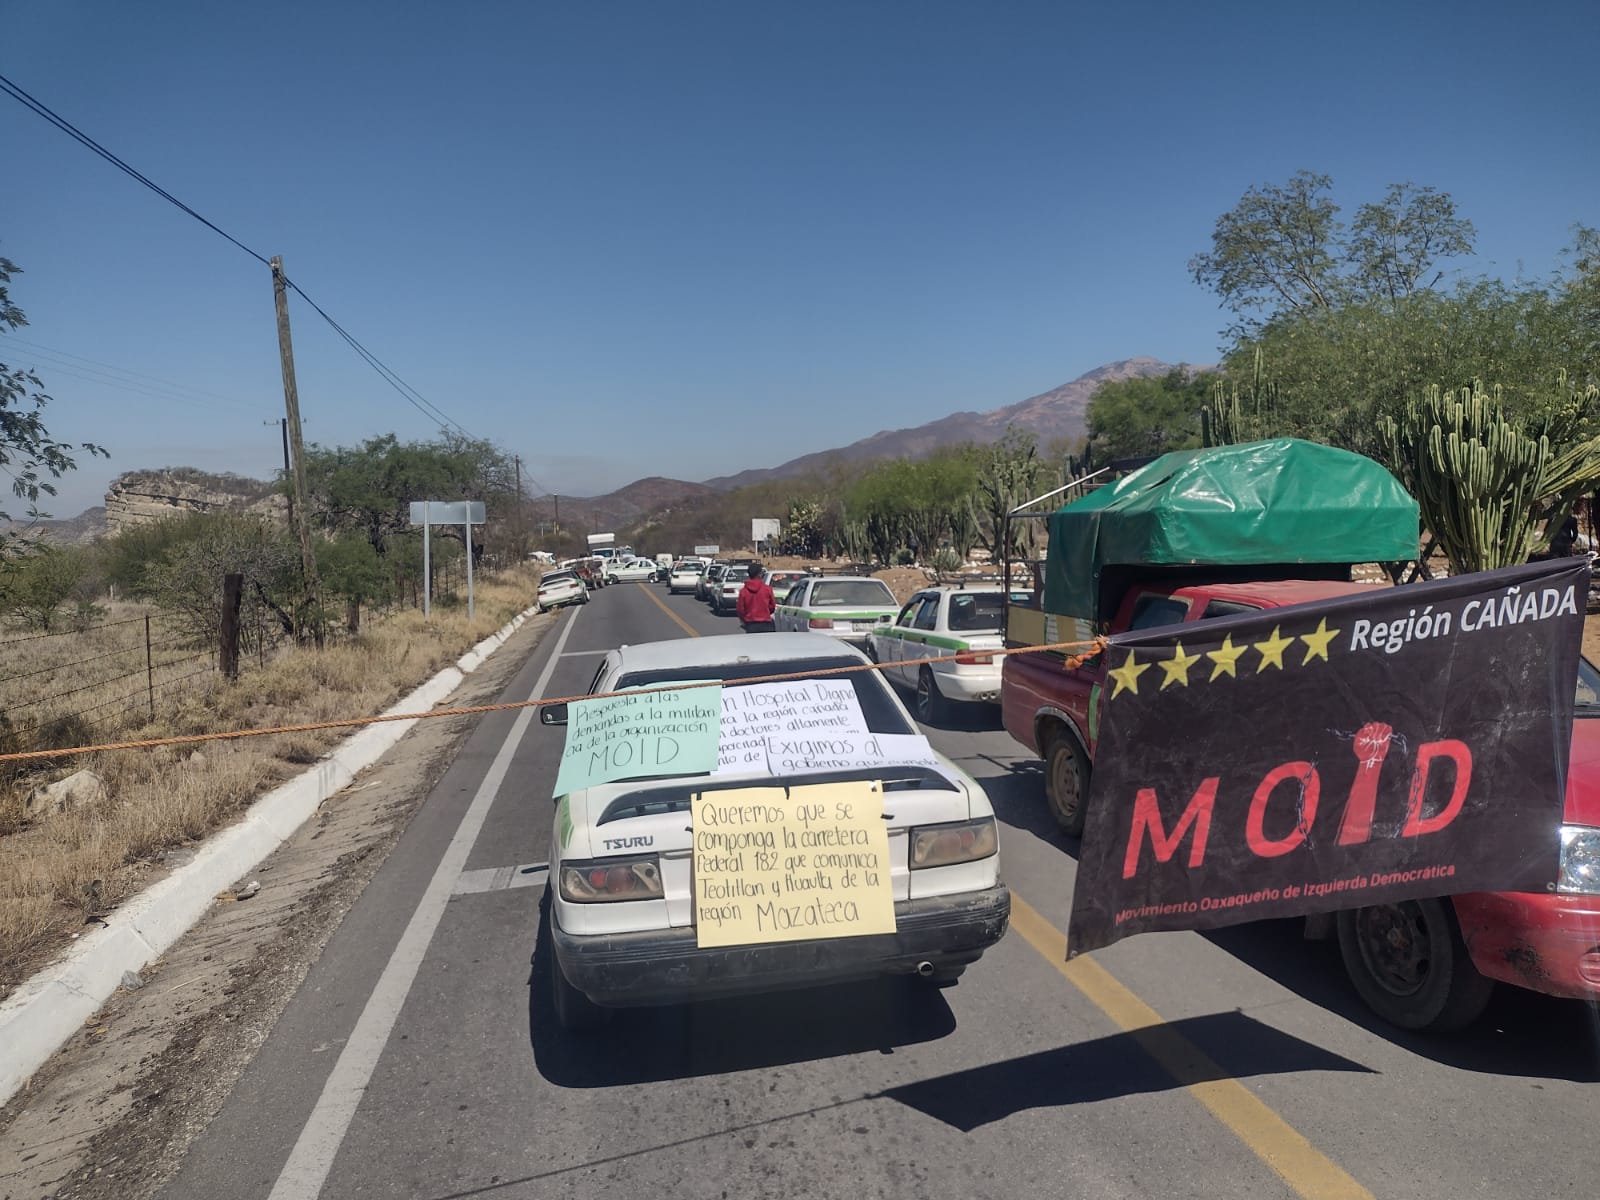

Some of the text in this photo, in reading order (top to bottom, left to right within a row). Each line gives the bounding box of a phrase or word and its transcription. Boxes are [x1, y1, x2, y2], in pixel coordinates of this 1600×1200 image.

[1350, 584, 1578, 655] Región CAÑADA
[644, 694, 653, 703] a
[657, 691, 680, 703] las
[742, 687, 811, 708] Hospital
[572, 714, 630, 742] demandas
[634, 711, 644, 720] a
[649, 706, 663, 720] la
[729, 722, 780, 739] doctores
[786, 715, 852, 731] altamente
[744, 711, 759, 723] la
[763, 705, 798, 721] región
[586, 735, 601, 749] de
[604, 728, 616, 742] la
[619, 720, 708, 739] organización
[768, 735, 885, 760] Exigimos al
[588, 737, 680, 776] MOID
[744, 751, 760, 763] de
[1121, 720, 1474, 880] MOID
[701, 802, 855, 829] Queremos que se
[602, 835, 654, 850] TSURU
[782, 826, 797, 849] la
[801, 825, 869, 846] carretera
[754, 851, 780, 872] 182
[784, 853, 807, 874] que
[813, 852, 878, 869] comunica
[771, 878, 780, 898] y
[841, 869, 859, 888] de
[864, 870, 880, 887] la
[1115, 863, 1456, 926] Movimiento Oaxaqueño de Izquierda Democrática
[700, 897, 860, 932] región Mazateca
